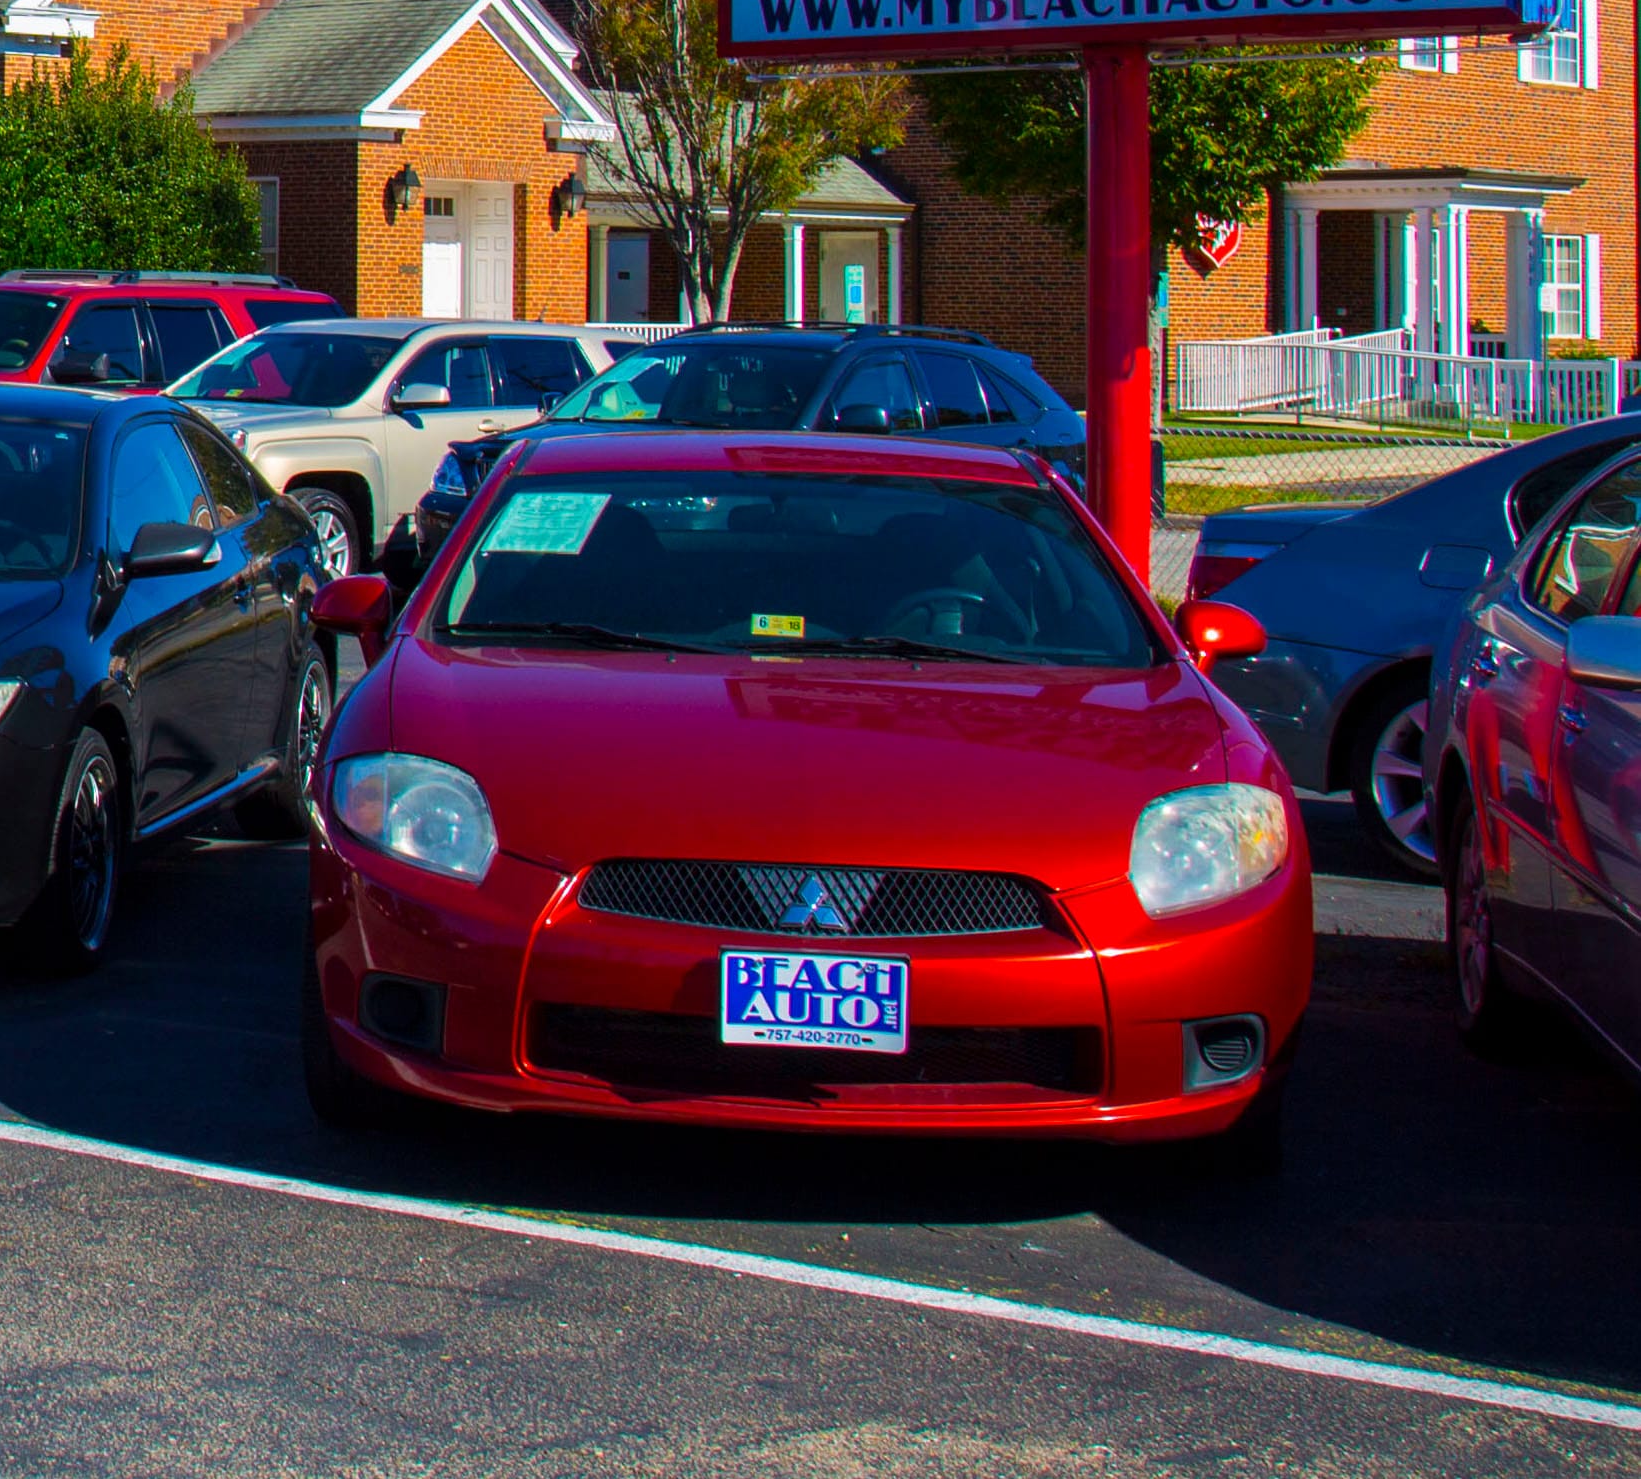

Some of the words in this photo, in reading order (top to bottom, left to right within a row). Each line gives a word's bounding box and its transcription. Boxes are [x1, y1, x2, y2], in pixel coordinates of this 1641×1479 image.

[727, 956, 902, 995] BEACH
[741, 990, 881, 1027] AUTO
[883, 999, 899, 1030] .net
[766, 1028, 861, 1045] 757-420-2770
